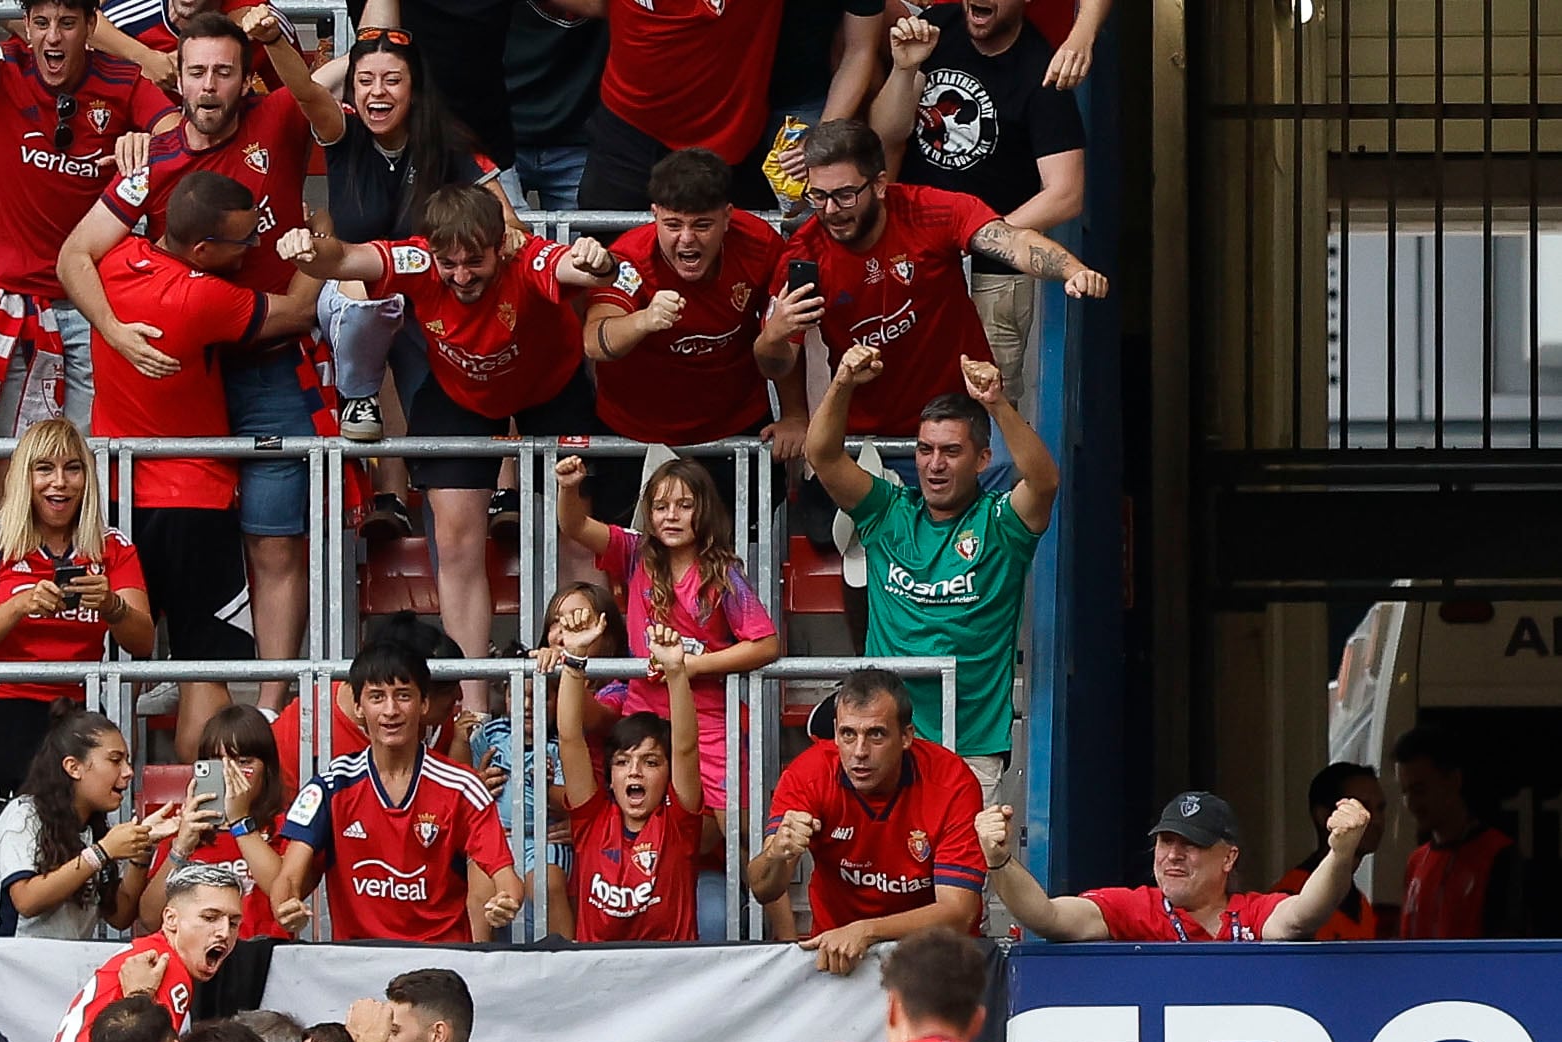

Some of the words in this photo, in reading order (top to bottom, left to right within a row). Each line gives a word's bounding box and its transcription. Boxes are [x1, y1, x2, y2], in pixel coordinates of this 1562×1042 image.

[1504, 615, 1562, 657] A
[352, 876, 428, 901] verleal
[839, 867, 932, 894] Noticias
